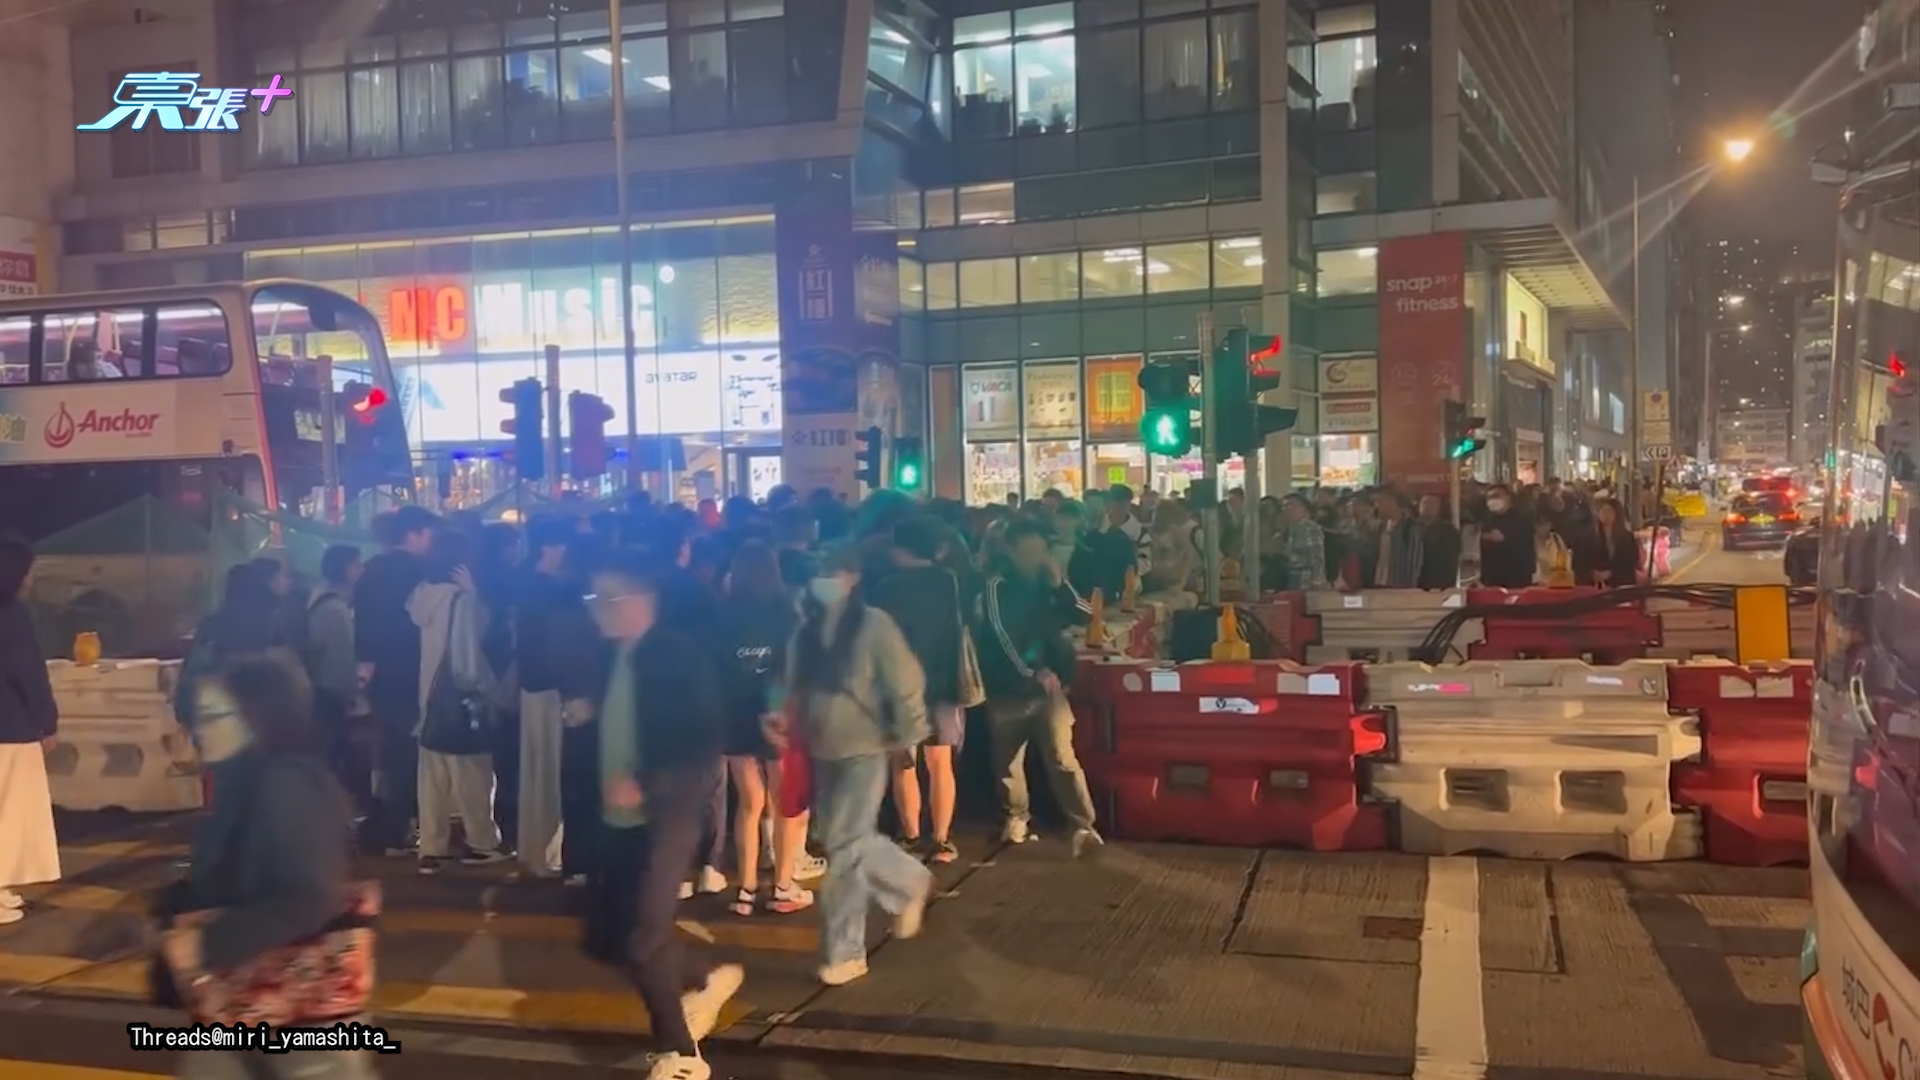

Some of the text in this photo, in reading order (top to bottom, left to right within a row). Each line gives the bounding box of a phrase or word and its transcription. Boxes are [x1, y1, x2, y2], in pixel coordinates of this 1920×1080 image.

[1386, 276, 1433, 293] snap
[474, 277, 653, 345] Music
[1396, 297, 1459, 313] fitness
[77, 408, 160, 433] Anchor
[1842, 956, 1870, 1040] 城巴
